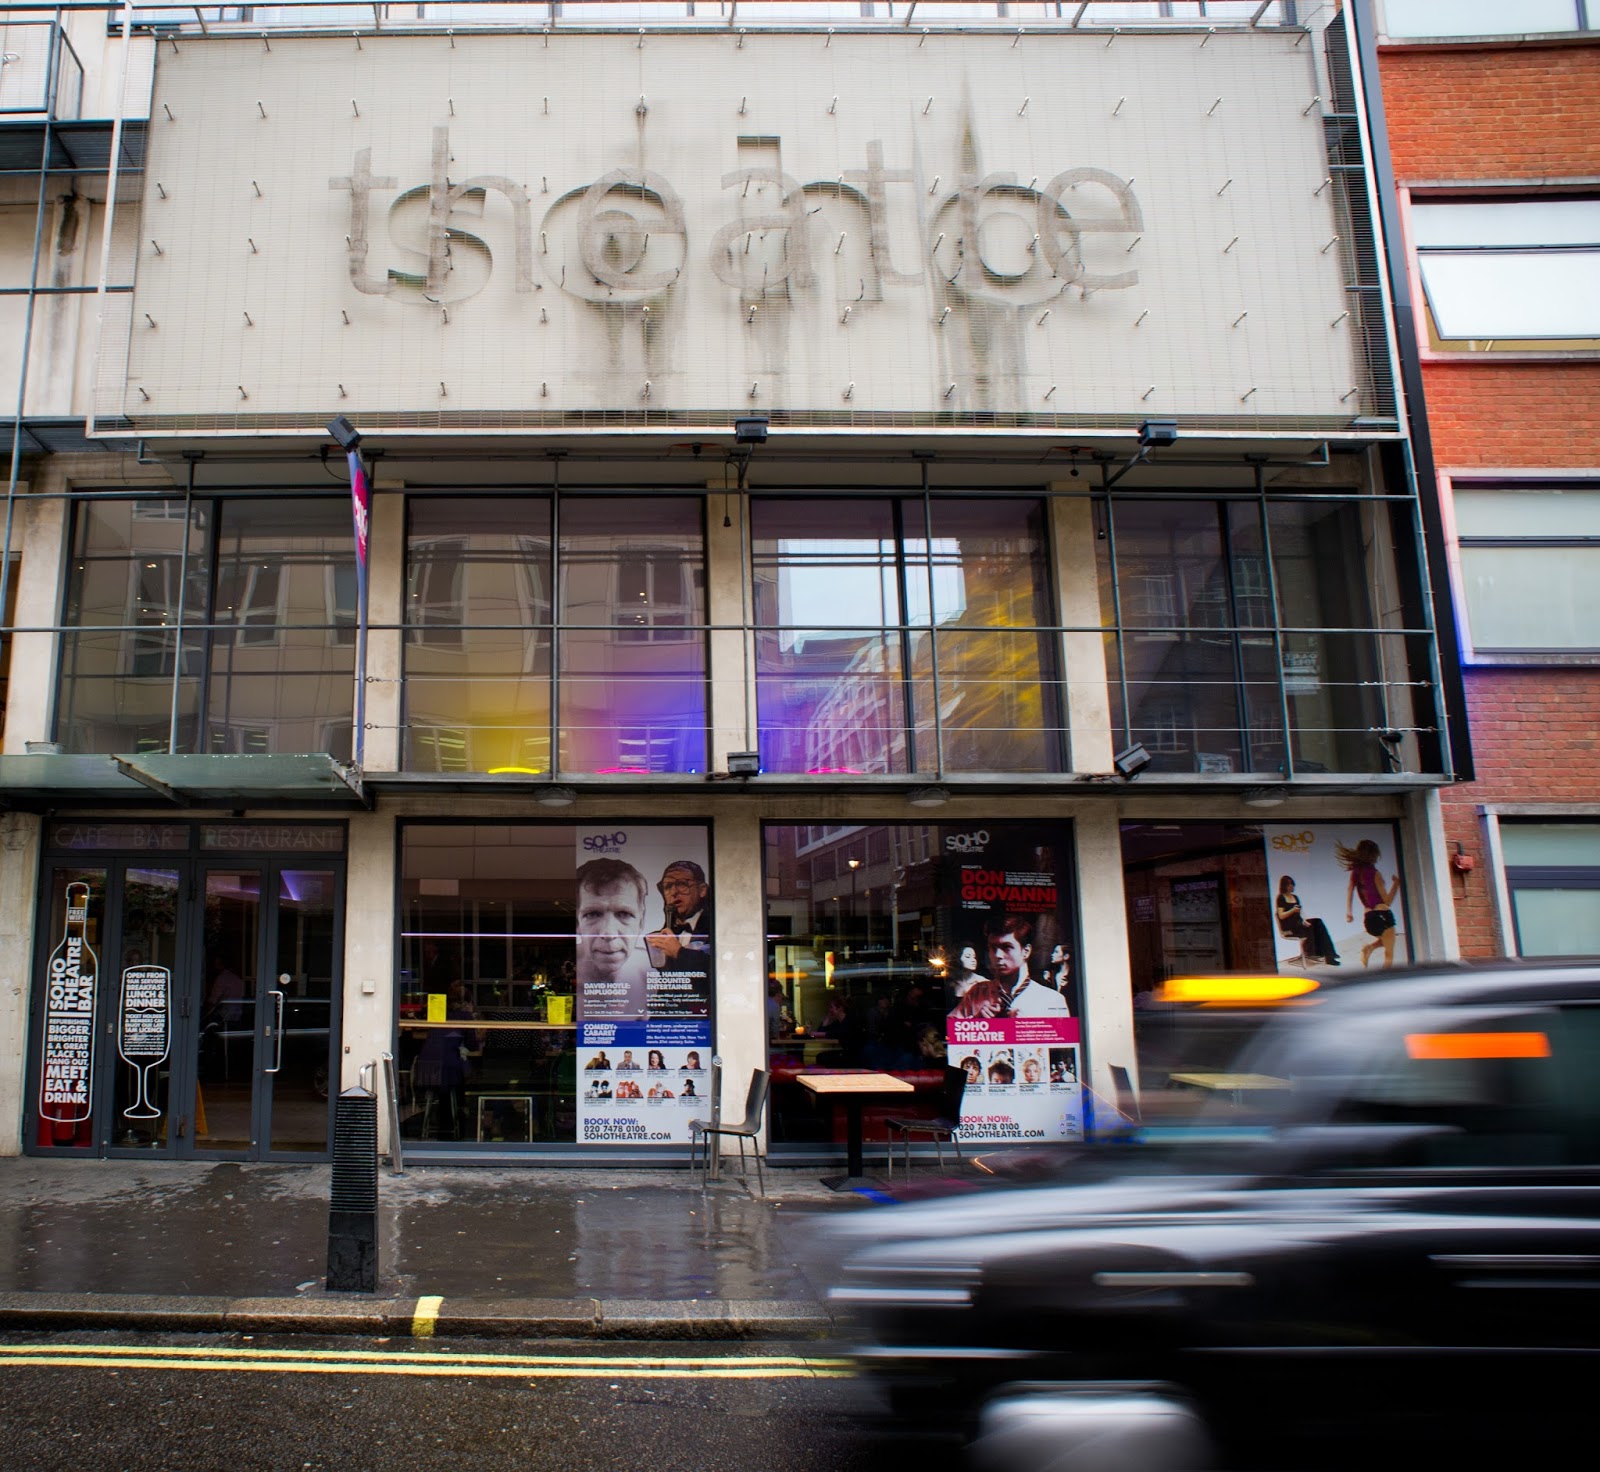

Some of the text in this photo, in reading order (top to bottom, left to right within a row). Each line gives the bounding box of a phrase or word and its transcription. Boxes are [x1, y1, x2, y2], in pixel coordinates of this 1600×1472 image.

[133, 828, 174, 847] BAR
[205, 829, 338, 849] RESTAURANT
[583, 831, 627, 850] SOHO
[945, 830, 990, 850] SOHO
[1271, 831, 1315, 850] SOHO
[961, 870, 1004, 885] DON
[962, 885, 1056, 902] GIOVANNI
[64, 937, 82, 1010] THEATRE
[50, 958, 66, 1010] SOHO
[77, 976, 94, 1010] BAR
[126, 990, 156, 998] LUNCH
[126, 998, 165, 1008] DINNER
[48, 1025, 91, 1035] BIGGER,
[954, 1021, 989, 1032] SOHO
[954, 1032, 1005, 1042] THEATRE
[47, 1050, 74, 1058] PLACE
[72, 1058, 89, 1066] OUT,
[46, 1065, 88, 1080] MEET,
[46, 1079, 87, 1092] EAT &
[45, 1092, 87, 1104] DRINK
[959, 1130, 1044, 1138] SOHOTHEATRE.COM
